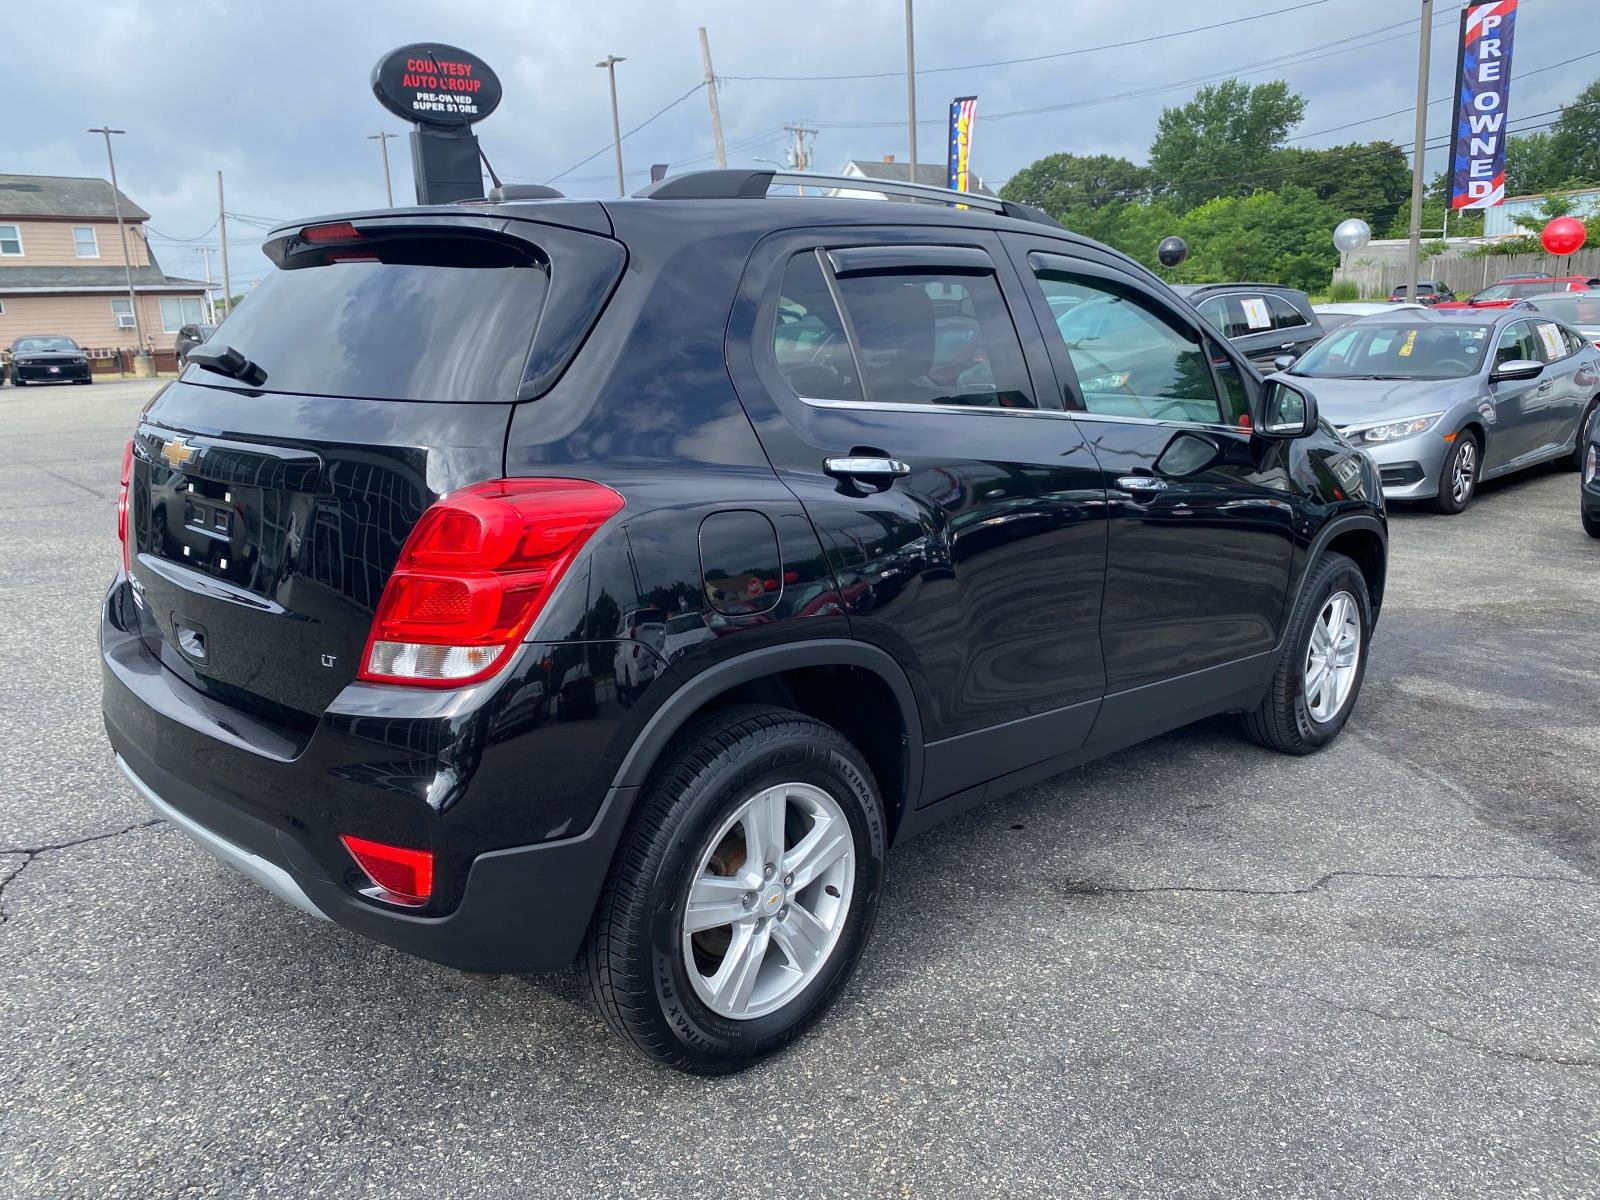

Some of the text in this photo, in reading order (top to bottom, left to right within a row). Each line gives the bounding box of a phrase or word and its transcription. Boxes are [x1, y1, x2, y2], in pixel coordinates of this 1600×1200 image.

[403, 75, 481, 92] AUTO GROUP
[417, 92, 472, 103] PRE-OWNED
[413, 101, 478, 113] SUPER STORE
[1468, 15, 1504, 199] PRE OWNED
[321, 654, 337, 668] LT
[834, 759, 876, 814] ALTIMAX
